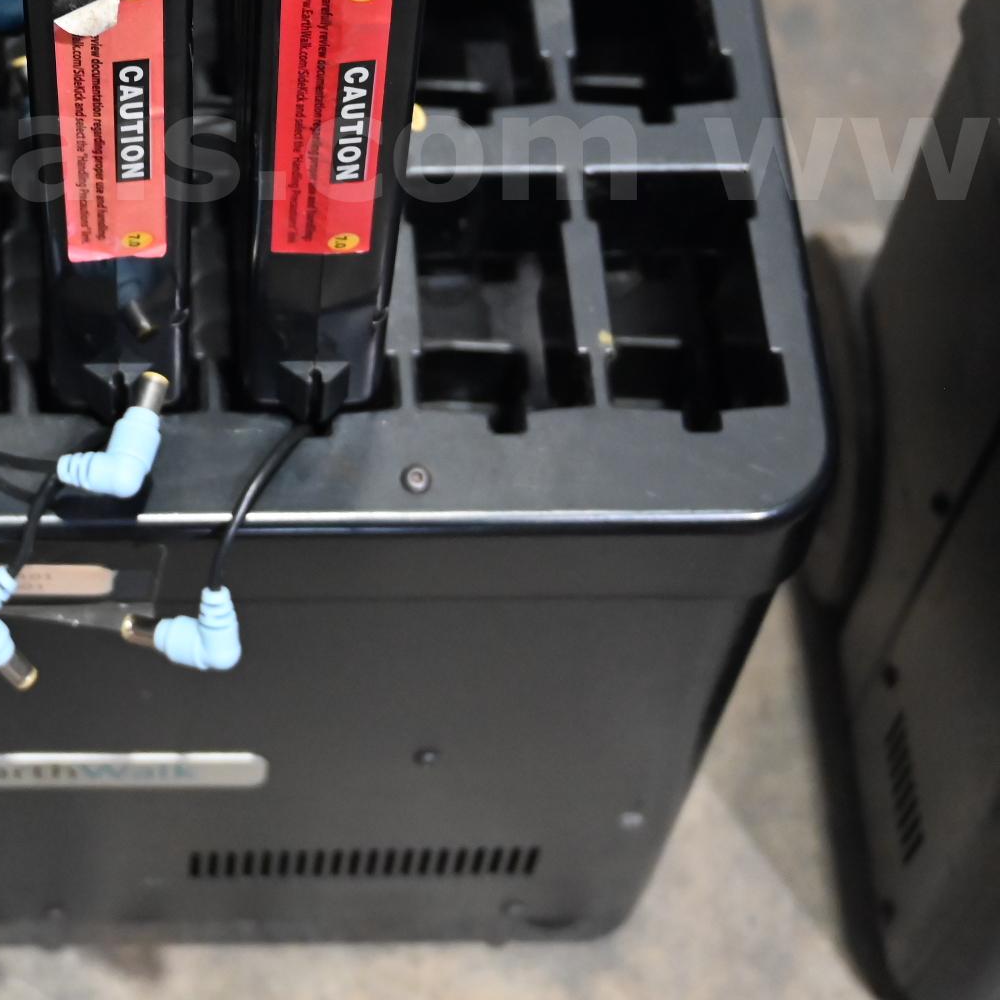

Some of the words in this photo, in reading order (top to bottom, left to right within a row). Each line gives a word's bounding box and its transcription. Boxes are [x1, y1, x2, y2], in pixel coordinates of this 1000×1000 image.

[90, 36, 102, 57] eview
[318, 31, 329, 58] review
[72, 35, 85, 101] alk.com/SideKick
[91, 59, 103, 117] documentation
[315, 60, 326, 118] documentation
[75, 102, 85, 117] and
[296, 103, 305, 118] and
[76, 120, 86, 139] select
[120, 66, 144, 178] CAUTION
[337, 67, 368, 180] CAUTION
[76, 140, 87, 153] the
[91, 120, 106, 155] regarding
[94, 156, 104, 181] proper
[96, 183, 104, 194] use
[96, 195, 106, 209] and
[129, 234, 141, 247] 7.0
[334, 236, 348, 249] 7.0
